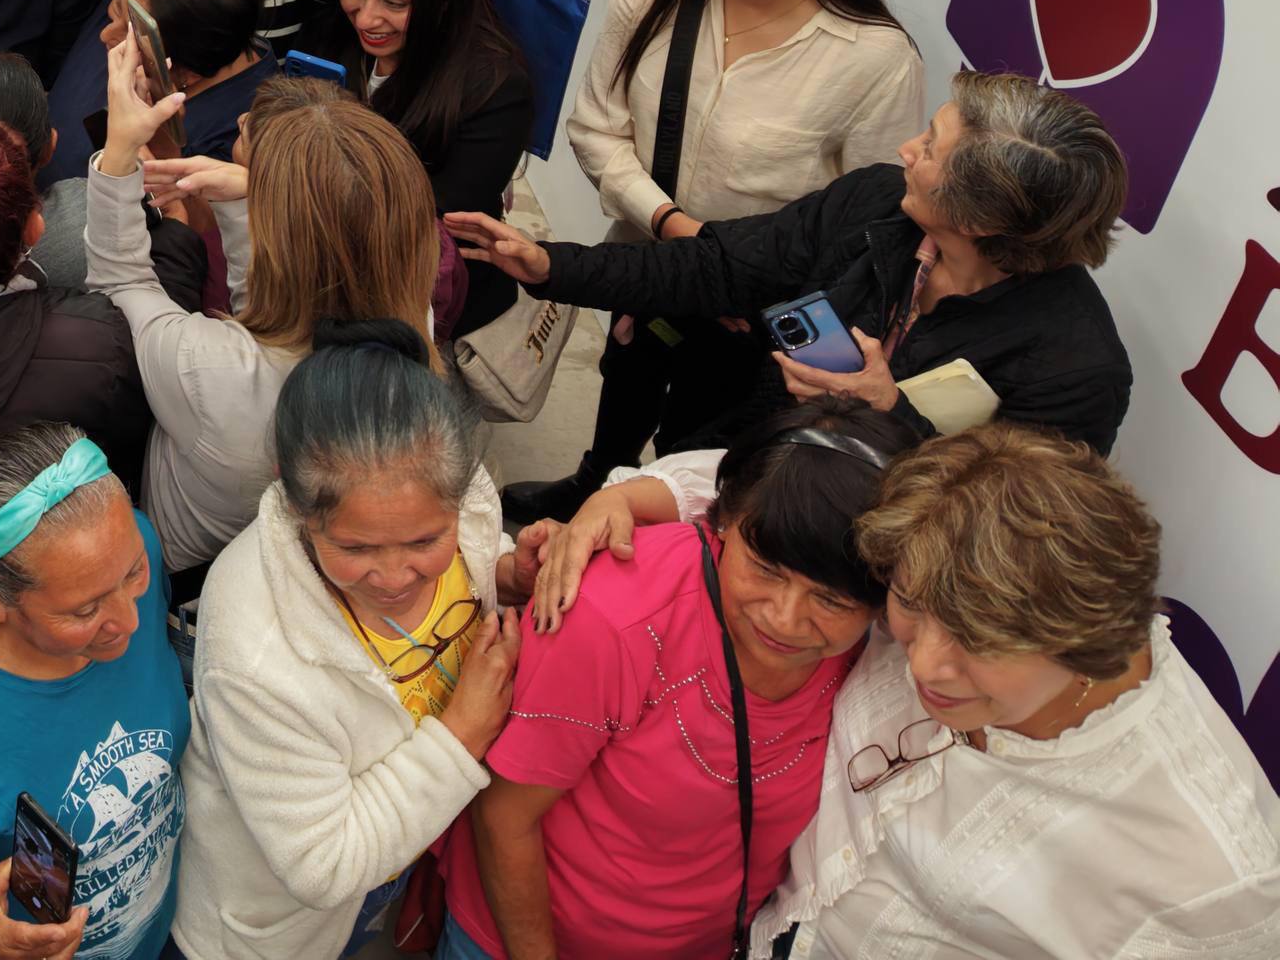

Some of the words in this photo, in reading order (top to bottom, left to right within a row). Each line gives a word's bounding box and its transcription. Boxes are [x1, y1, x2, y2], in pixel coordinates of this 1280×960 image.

[71, 792, 86, 812] A
[79, 736, 135, 792] SMOOTH
[138, 731, 165, 751] SEA
